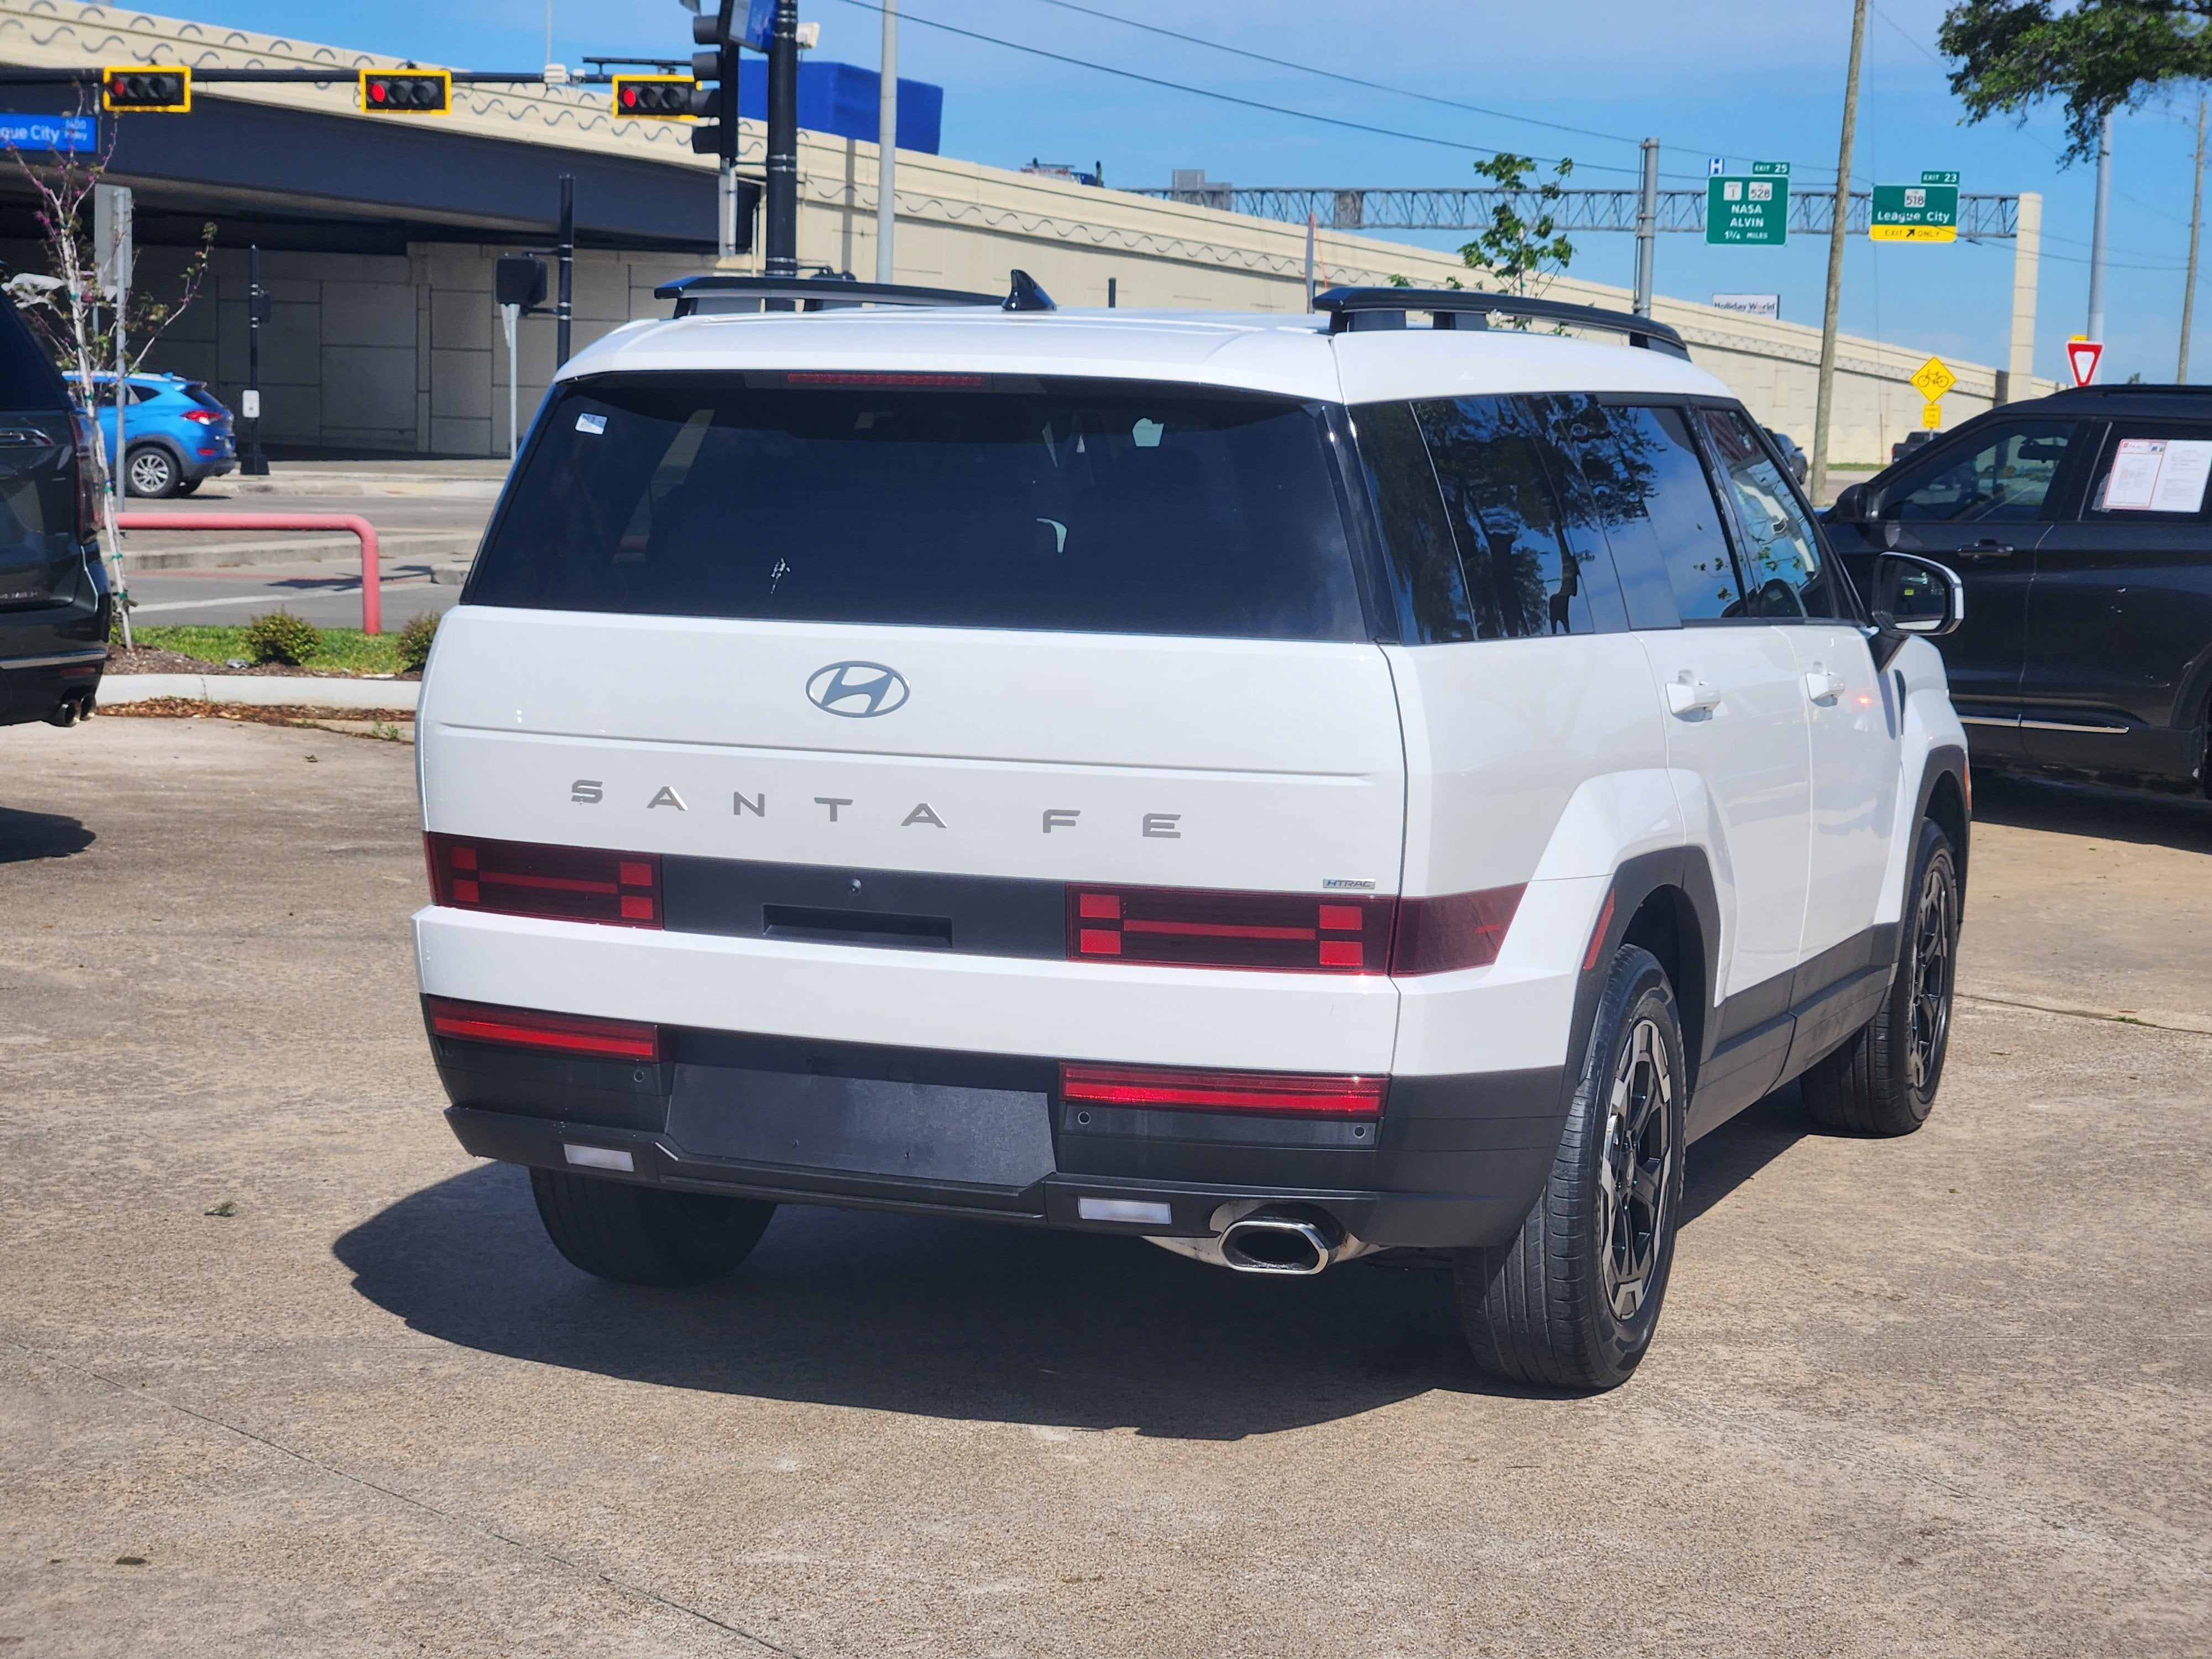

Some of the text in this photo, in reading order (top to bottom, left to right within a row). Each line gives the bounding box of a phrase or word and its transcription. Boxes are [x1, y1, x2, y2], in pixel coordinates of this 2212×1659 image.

[30, 124, 60, 144] City
[1944, 173, 1957, 182] 23
[1751, 189, 1770, 199] 528
[1906, 195, 1924, 206] 518
[1731, 204, 1762, 214] NASA
[1729, 217, 1764, 227] ALVIN
[1877, 211, 1950, 223] League City
[571, 779, 1182, 839] SANTA FE
